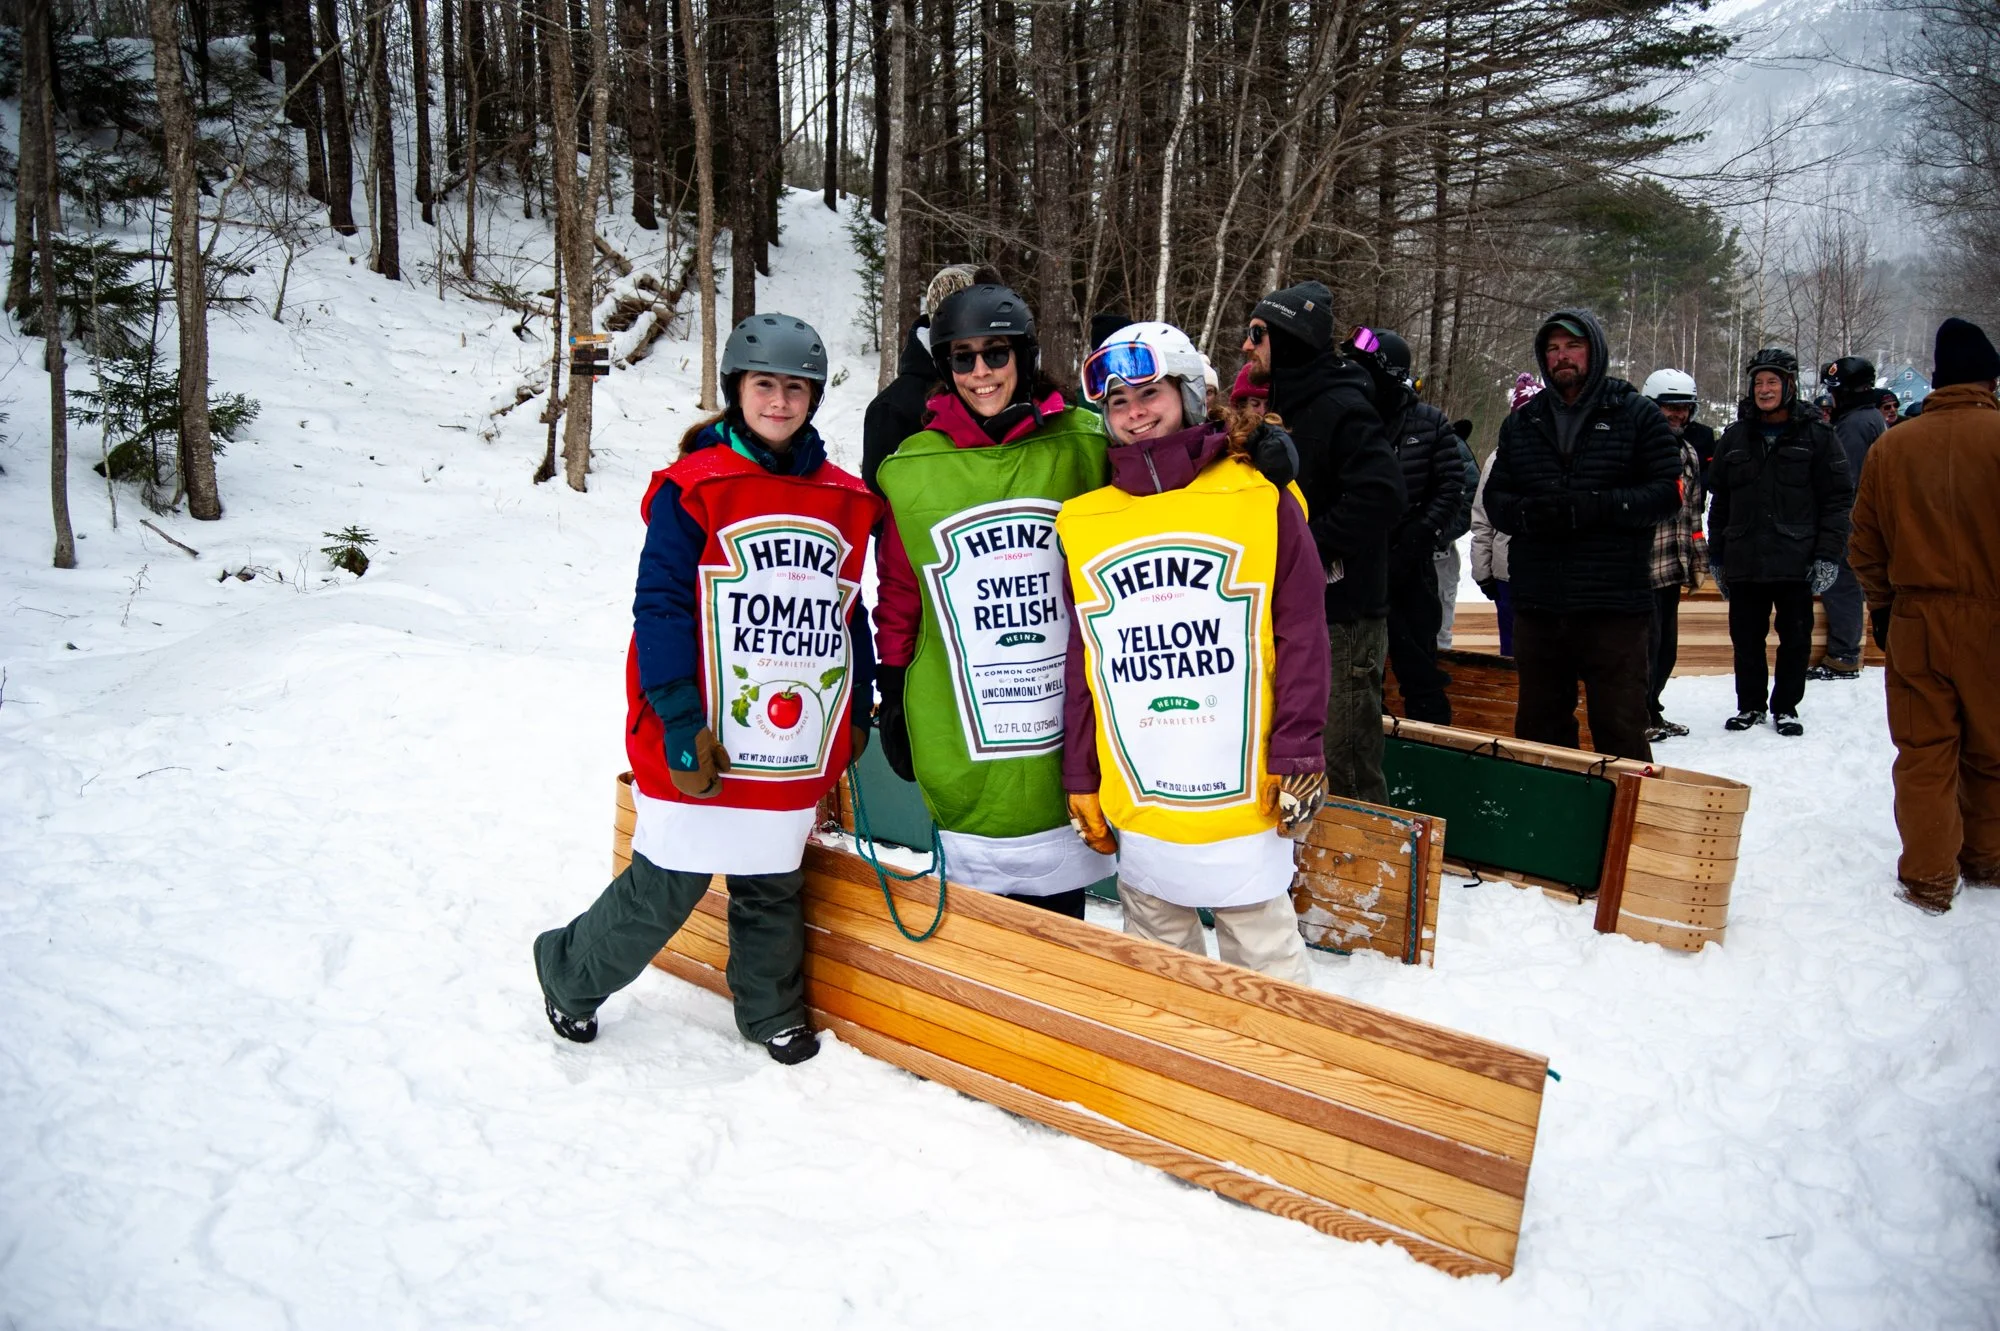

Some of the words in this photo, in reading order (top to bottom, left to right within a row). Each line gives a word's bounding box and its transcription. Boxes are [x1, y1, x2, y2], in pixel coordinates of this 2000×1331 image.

[964, 524, 1053, 558] HEINZ
[749, 539, 837, 578] HEINZ
[1004, 553, 1023, 561] 1869
[788, 571, 807, 581] 1869
[1110, 557, 1214, 600] HEINZ
[976, 572, 1051, 601] SWEET
[1151, 592, 1174, 603] 1869
[973, 596, 1058, 631] RELISH
[733, 626, 843, 658] KETCHUP
[1006, 634, 1038, 644] HEINZ
[1117, 618, 1221, 654] YELLOW
[757, 658, 772, 667] 57
[773, 660, 817, 669] VARIETIES
[984, 669, 1022, 677] COMMON
[1025, 660, 1066, 674] CONDIMENT
[1111, 647, 1235, 683] MUSTARD
[981, 684, 1042, 699] UNCOMMONLY
[1044, 678, 1064, 693] WELL
[1157, 699, 1189, 708] HEINZ
[994, 723, 1010, 734] 12.7
[1011, 722, 1021, 733] FL
[1022, 722, 1032, 733] OZ
[1139, 717, 1154, 728] 57
[1156, 715, 1216, 725] VARIETIES
[738, 752, 750, 761] NET
[750, 753, 760, 762] WT
[760, 754, 767, 763] 20
[767, 755, 776, 764] OZ
